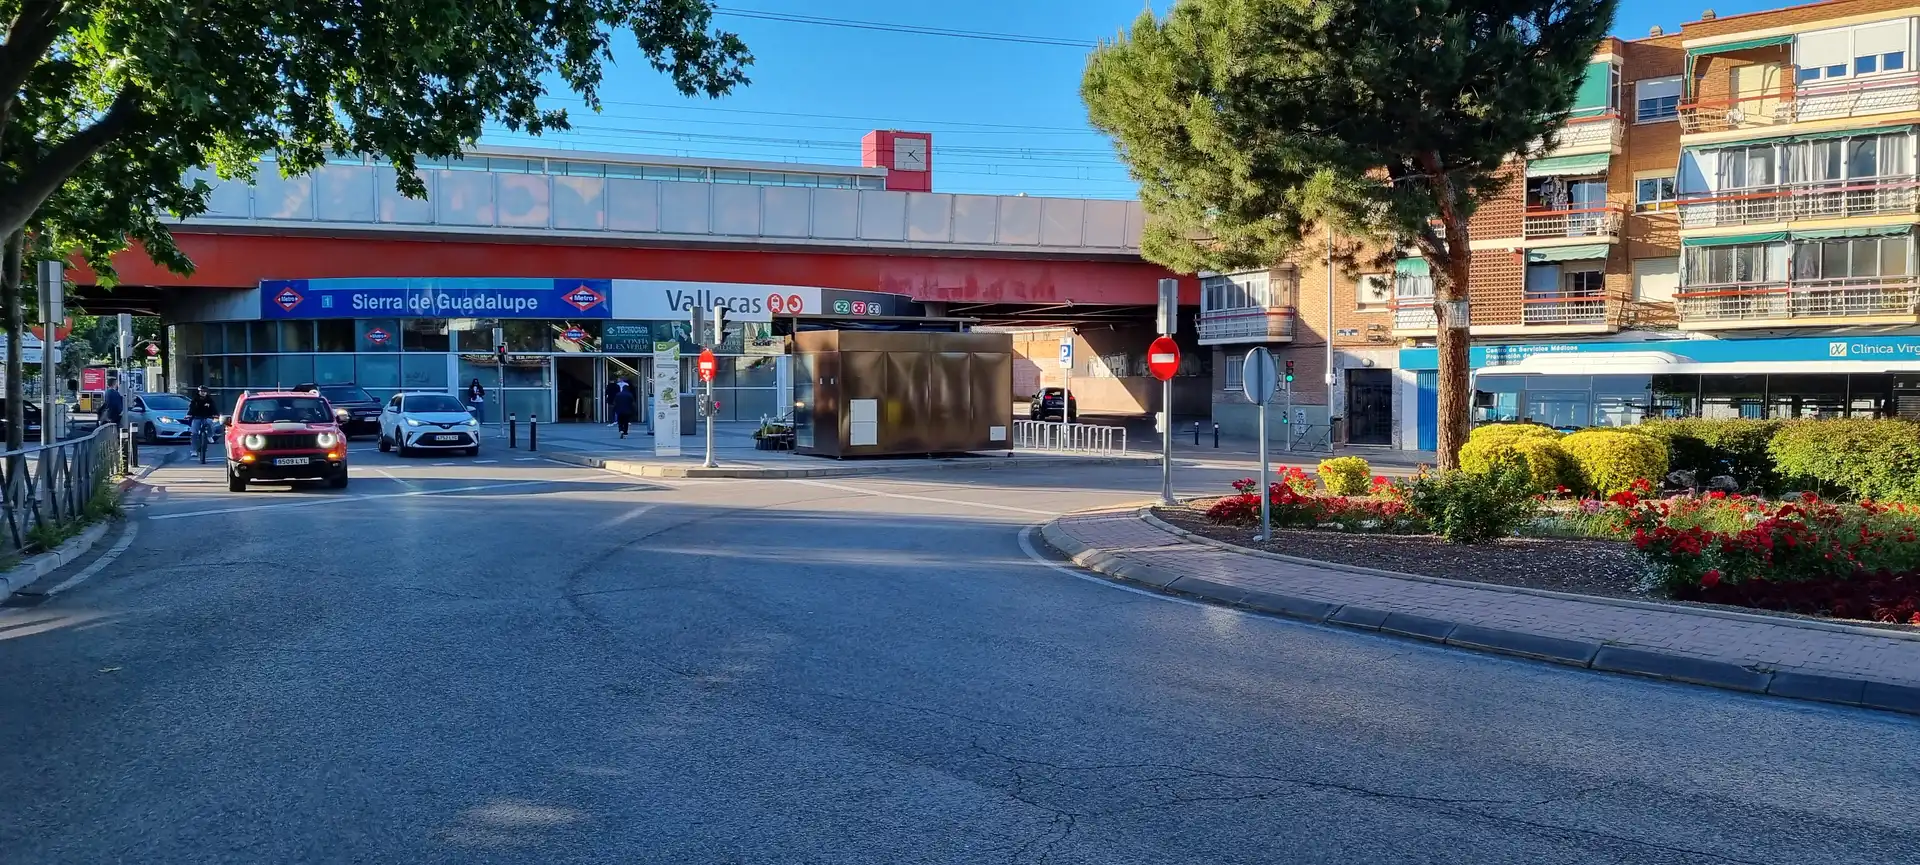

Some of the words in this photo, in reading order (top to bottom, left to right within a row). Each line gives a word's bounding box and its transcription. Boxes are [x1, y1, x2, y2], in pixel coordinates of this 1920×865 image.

[353, 294, 402, 309] Sierra
[409, 294, 430, 309] de
[437, 293, 538, 313] Guadalupe
[665, 289, 762, 314] Vallecas
[835, 302, 848, 312] C-2
[852, 303, 864, 313] C-7
[616, 326, 648, 334] TECNOCASA
[1851, 343, 1894, 354] Clínica
